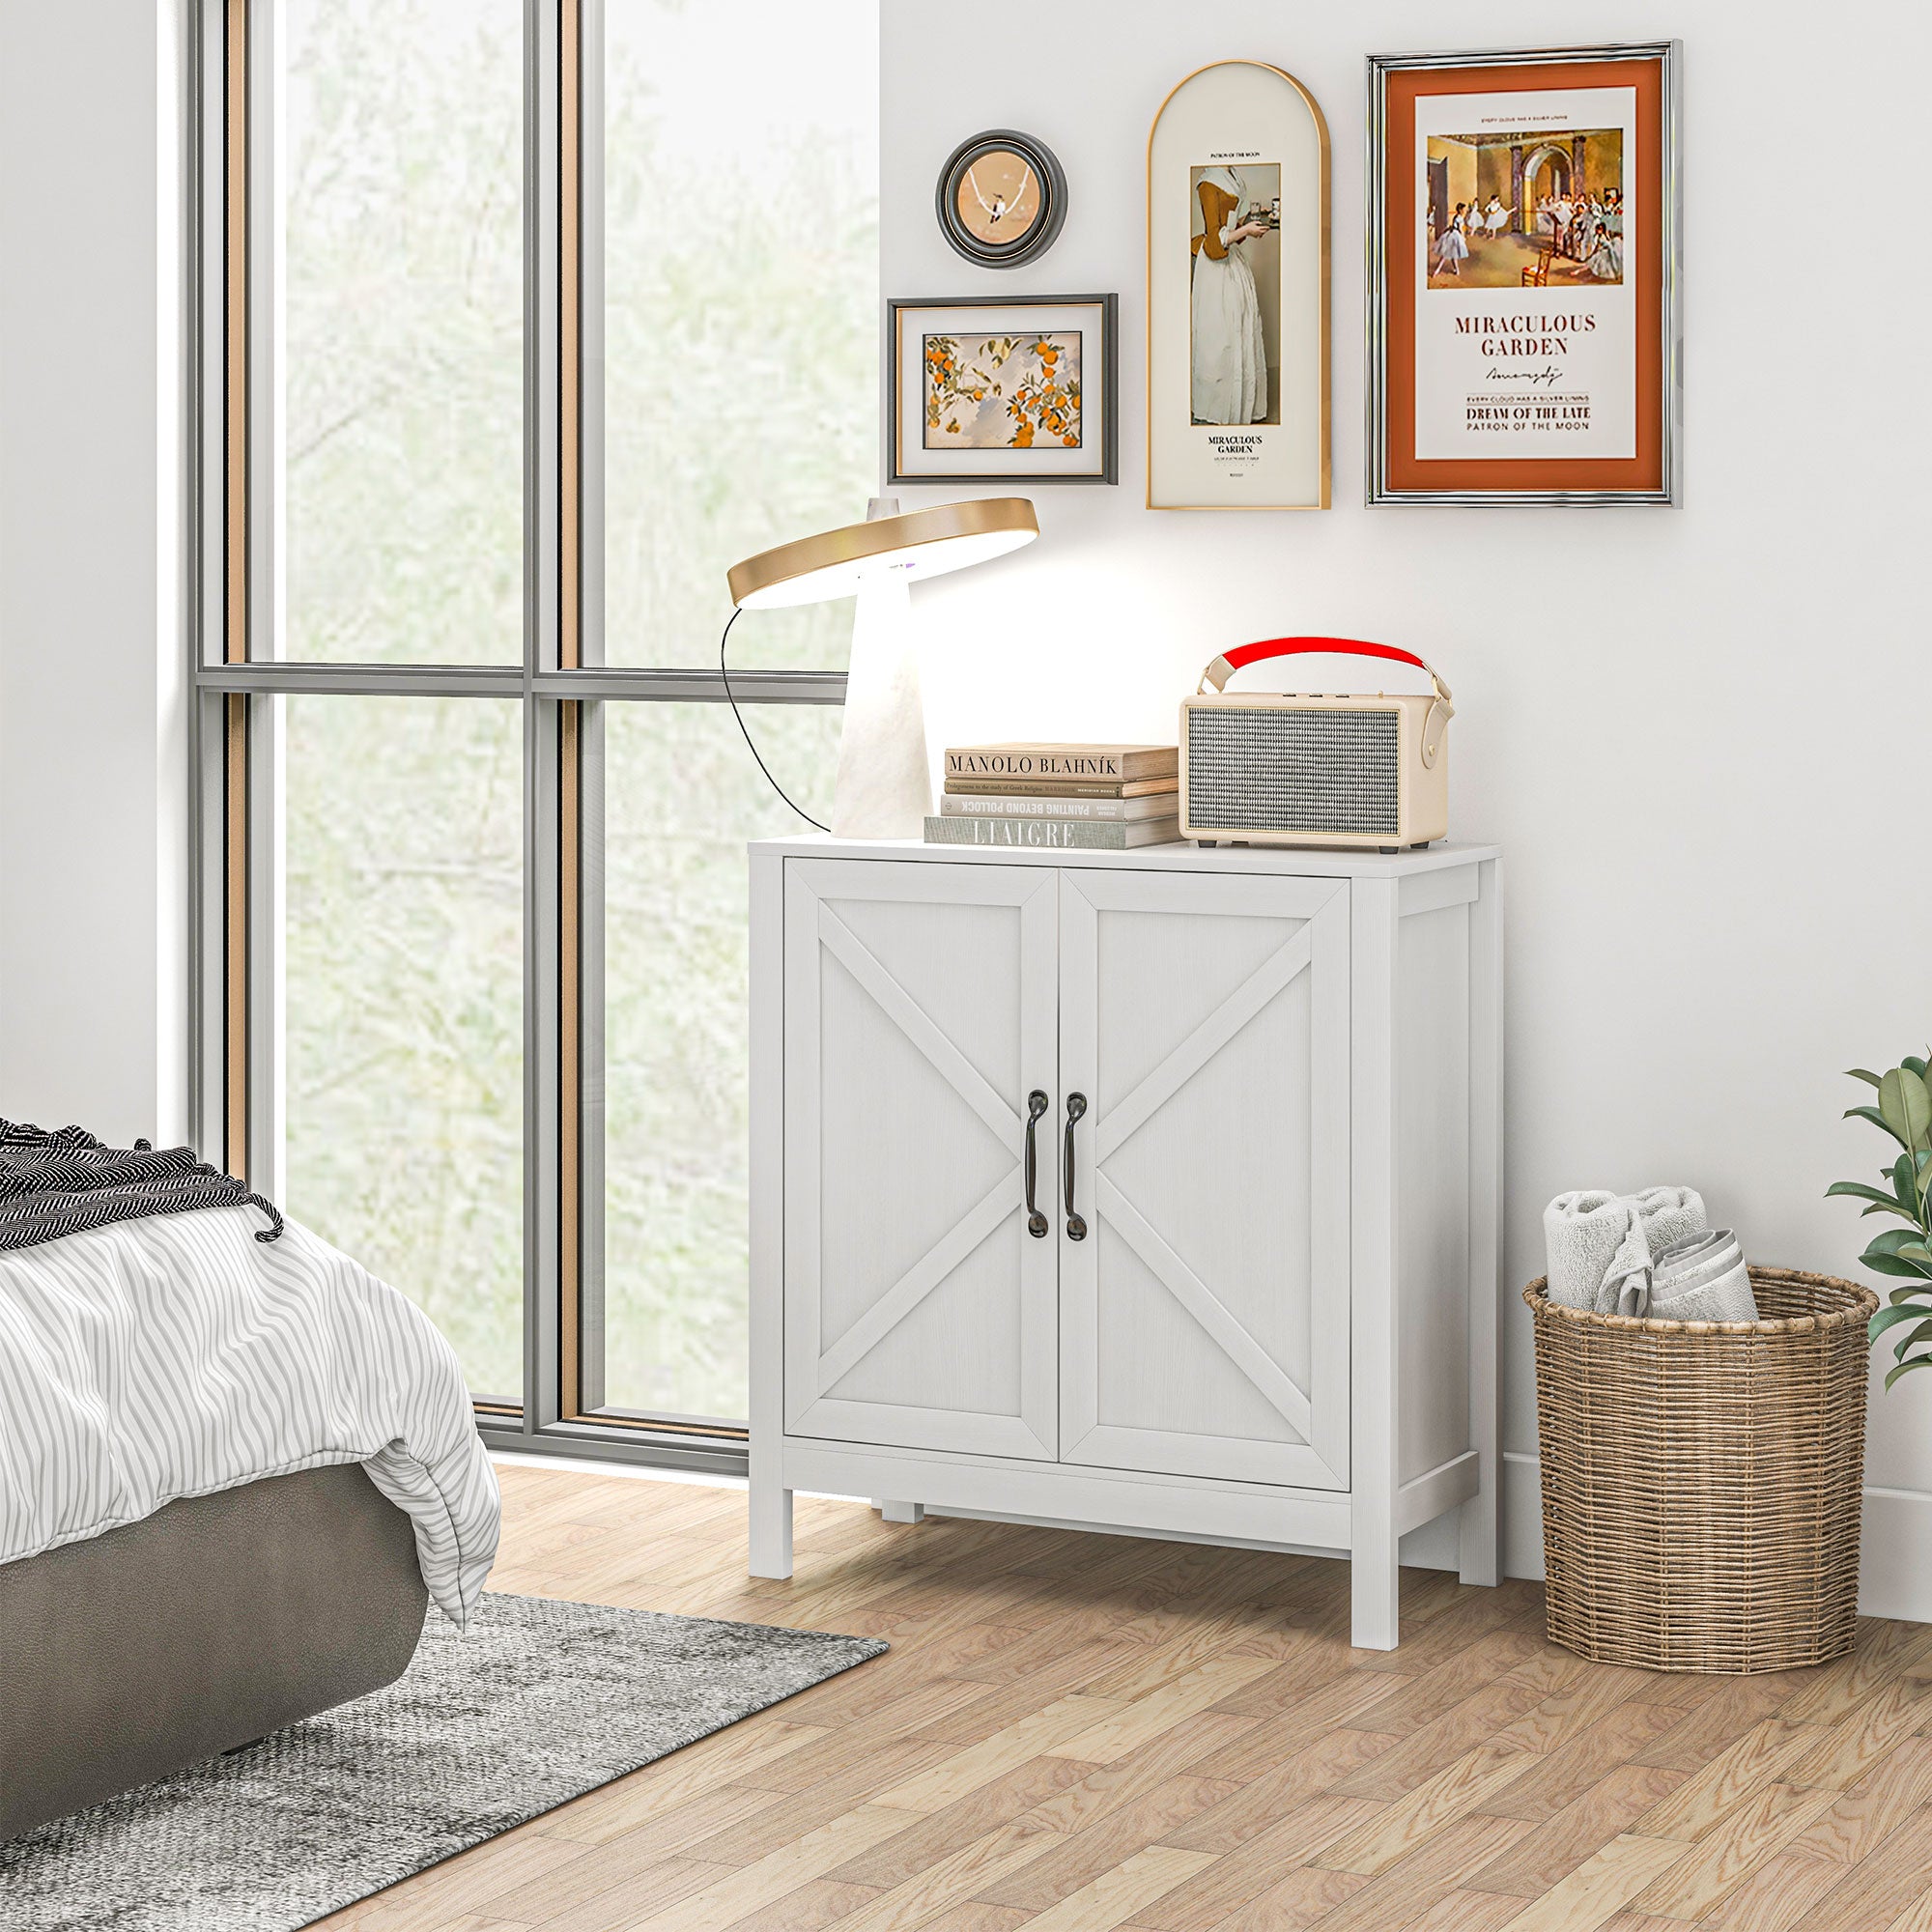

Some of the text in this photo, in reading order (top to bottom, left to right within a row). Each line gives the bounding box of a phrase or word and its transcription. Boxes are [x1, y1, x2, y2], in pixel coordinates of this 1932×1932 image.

[1455, 314, 1596, 333] MIRACULOUS
[1481, 337, 1568, 356] GARDEN
[1466, 407, 1591, 420] DREAM OF THE LATE
[1466, 422, 1589, 431] PATRON OF THE MOON
[1208, 436, 1263, 444] MIRACULOUS
[949, 755, 1117, 774] MANOLO BLAHNÍK
[961, 801, 1090, 816] PAINTING BEYOND POLLOCK
[974, 821, 1075, 847] LIAIGRE
